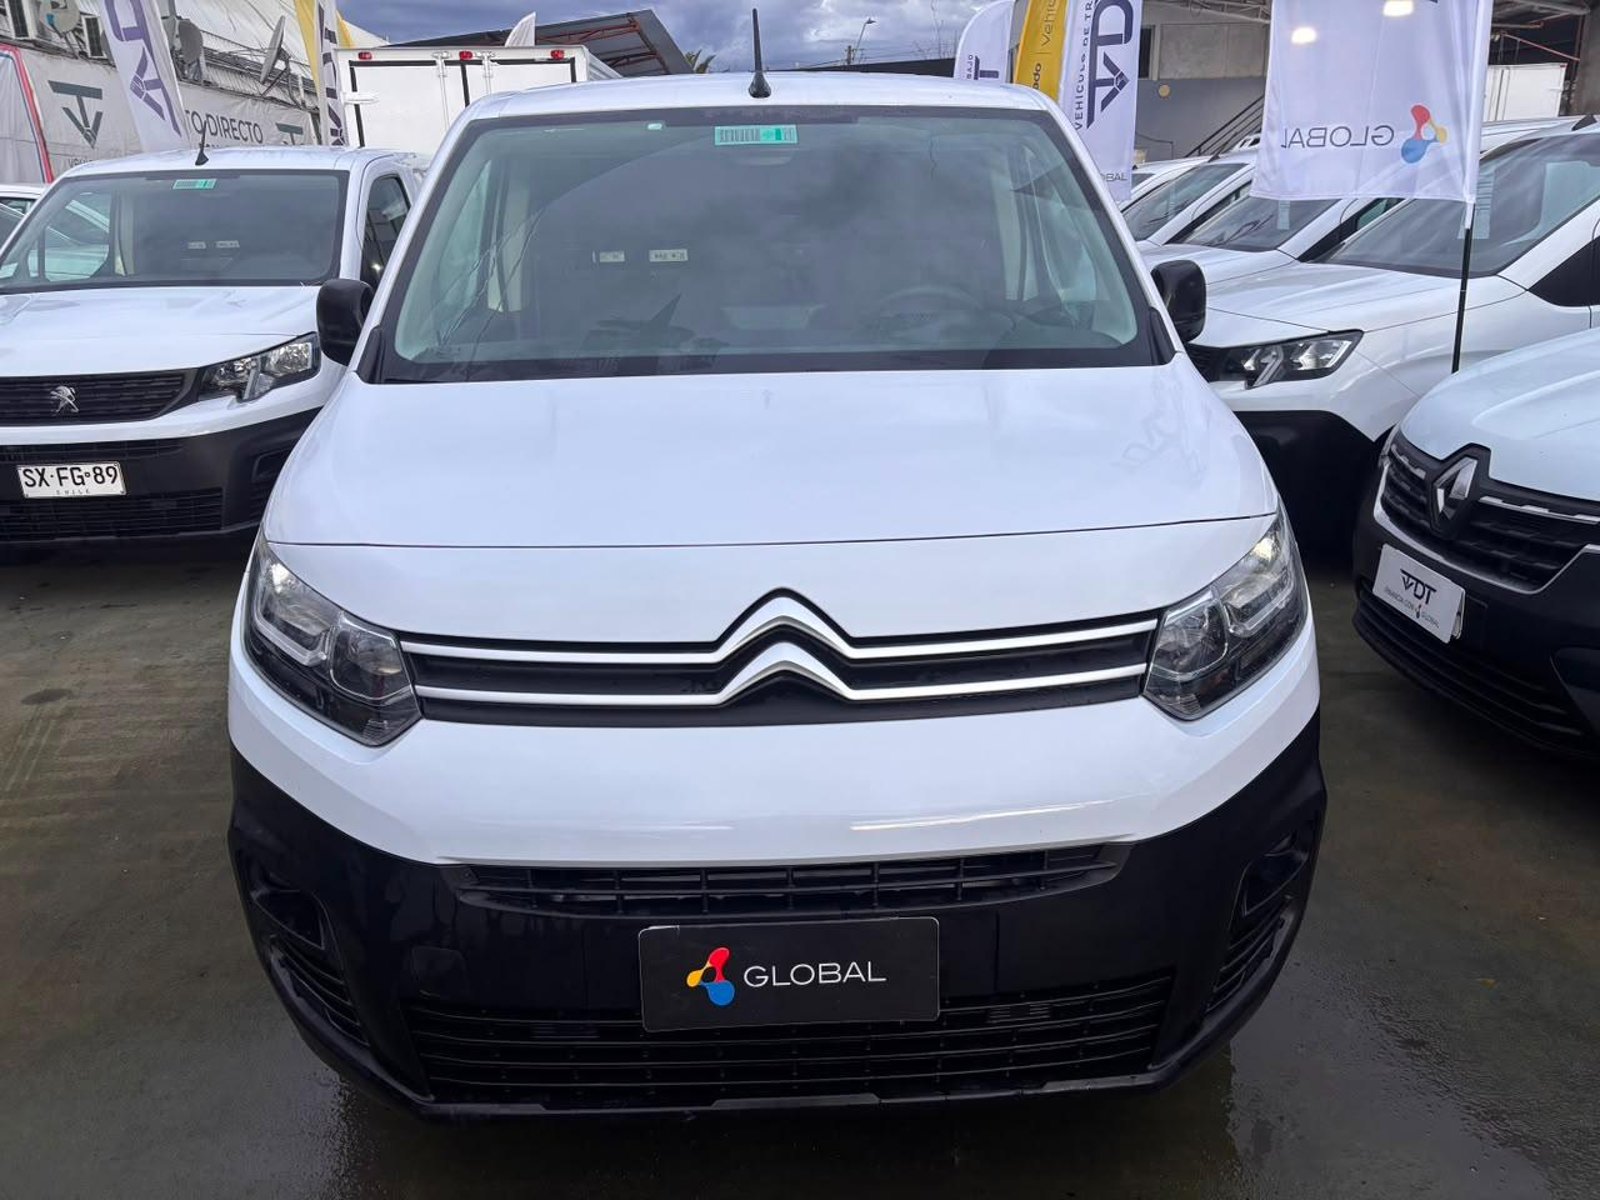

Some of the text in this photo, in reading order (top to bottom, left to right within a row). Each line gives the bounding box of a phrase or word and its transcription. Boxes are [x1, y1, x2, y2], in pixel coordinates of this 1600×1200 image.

[1074, 53, 1087, 131] VEHICULO
[1083, 27, 1090, 47] DE
[205, 113, 264, 144] DIRECTO
[743, 961, 887, 988] GLOBAL
